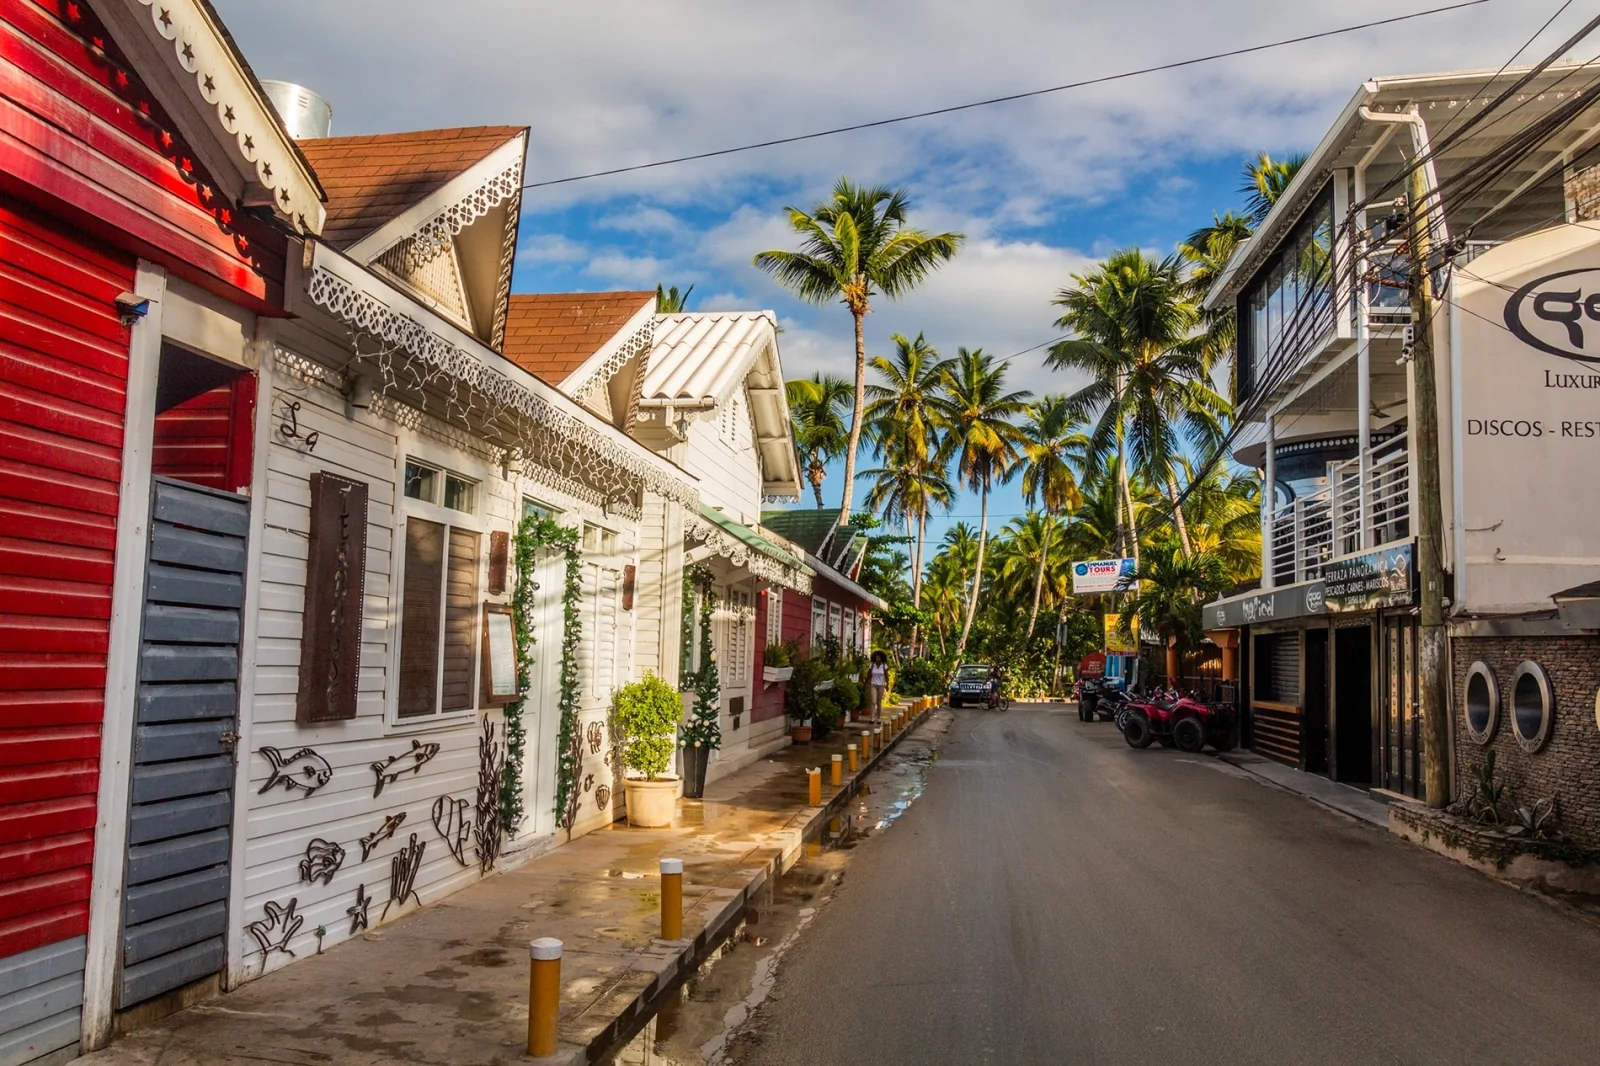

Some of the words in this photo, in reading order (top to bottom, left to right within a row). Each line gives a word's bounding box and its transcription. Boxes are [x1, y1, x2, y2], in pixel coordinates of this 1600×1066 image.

[1467, 419, 1543, 438] DISCOS
[1325, 569, 1348, 583] TERRAZA
[1347, 596, 1359, 605] SUSHI
[1359, 594, 1367, 603] BAR
